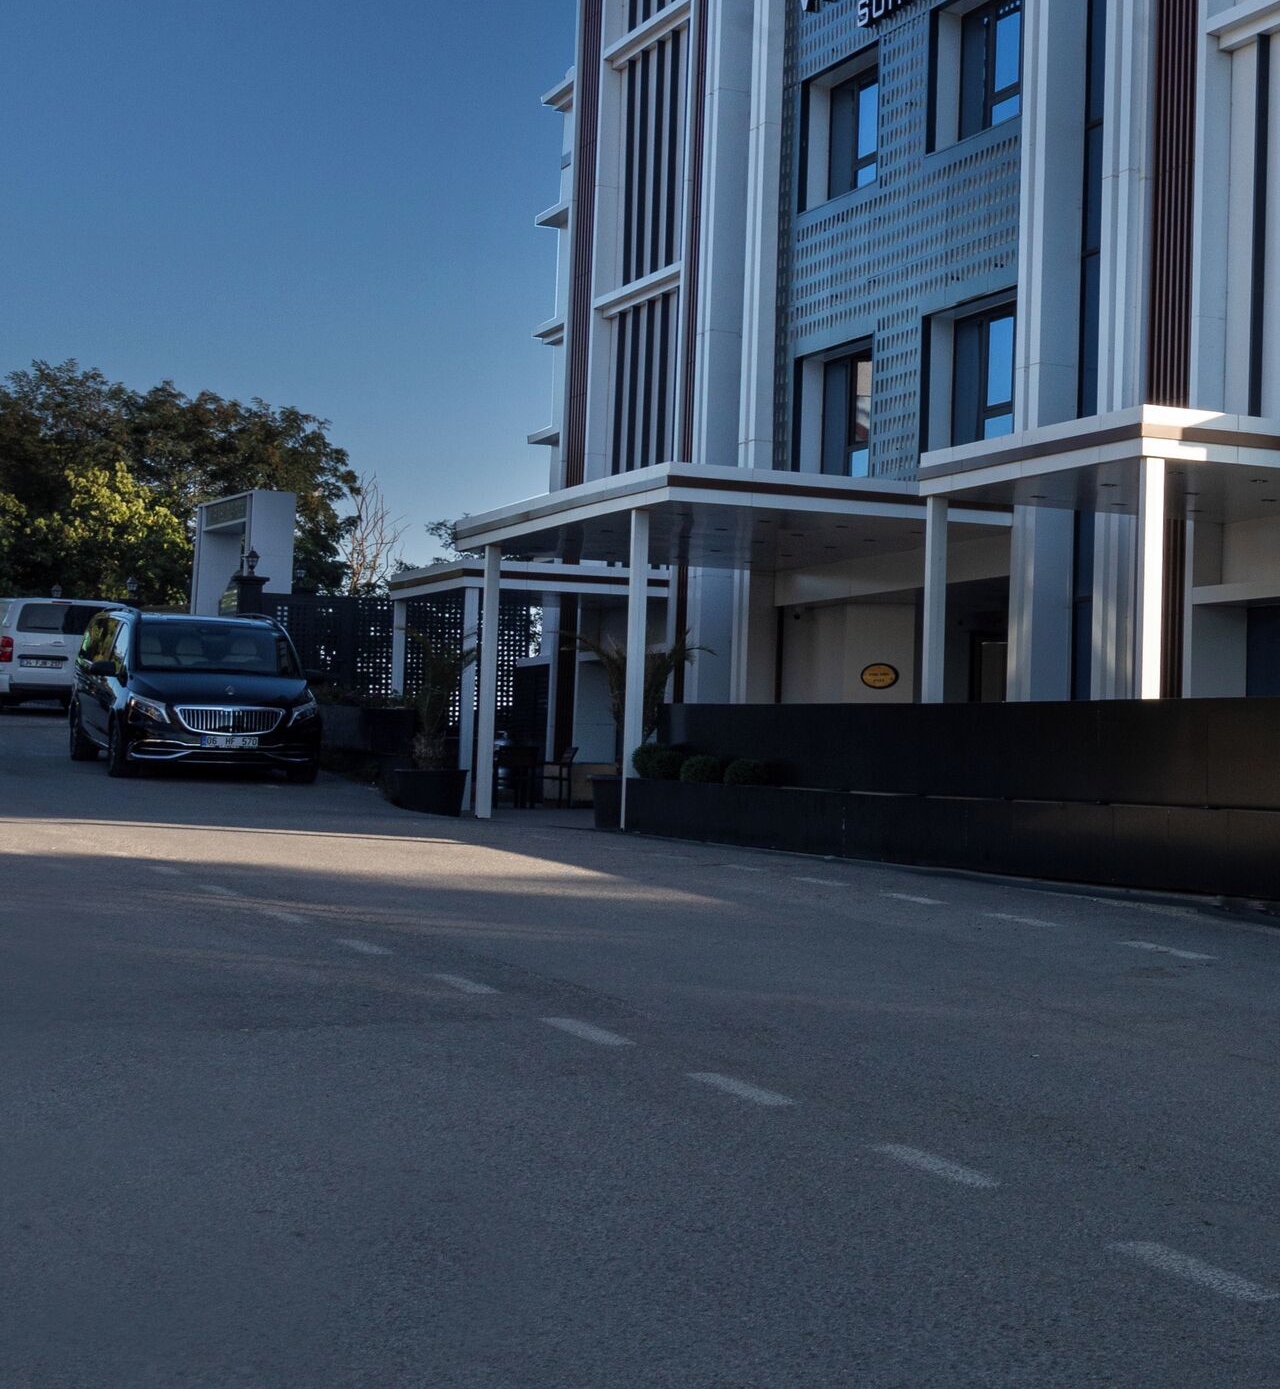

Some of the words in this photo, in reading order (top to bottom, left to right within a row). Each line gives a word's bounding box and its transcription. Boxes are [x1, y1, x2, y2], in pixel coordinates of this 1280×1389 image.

[207, 736, 218, 745] 06
[225, 737, 236, 745] HF
[241, 737, 258, 746] 570
